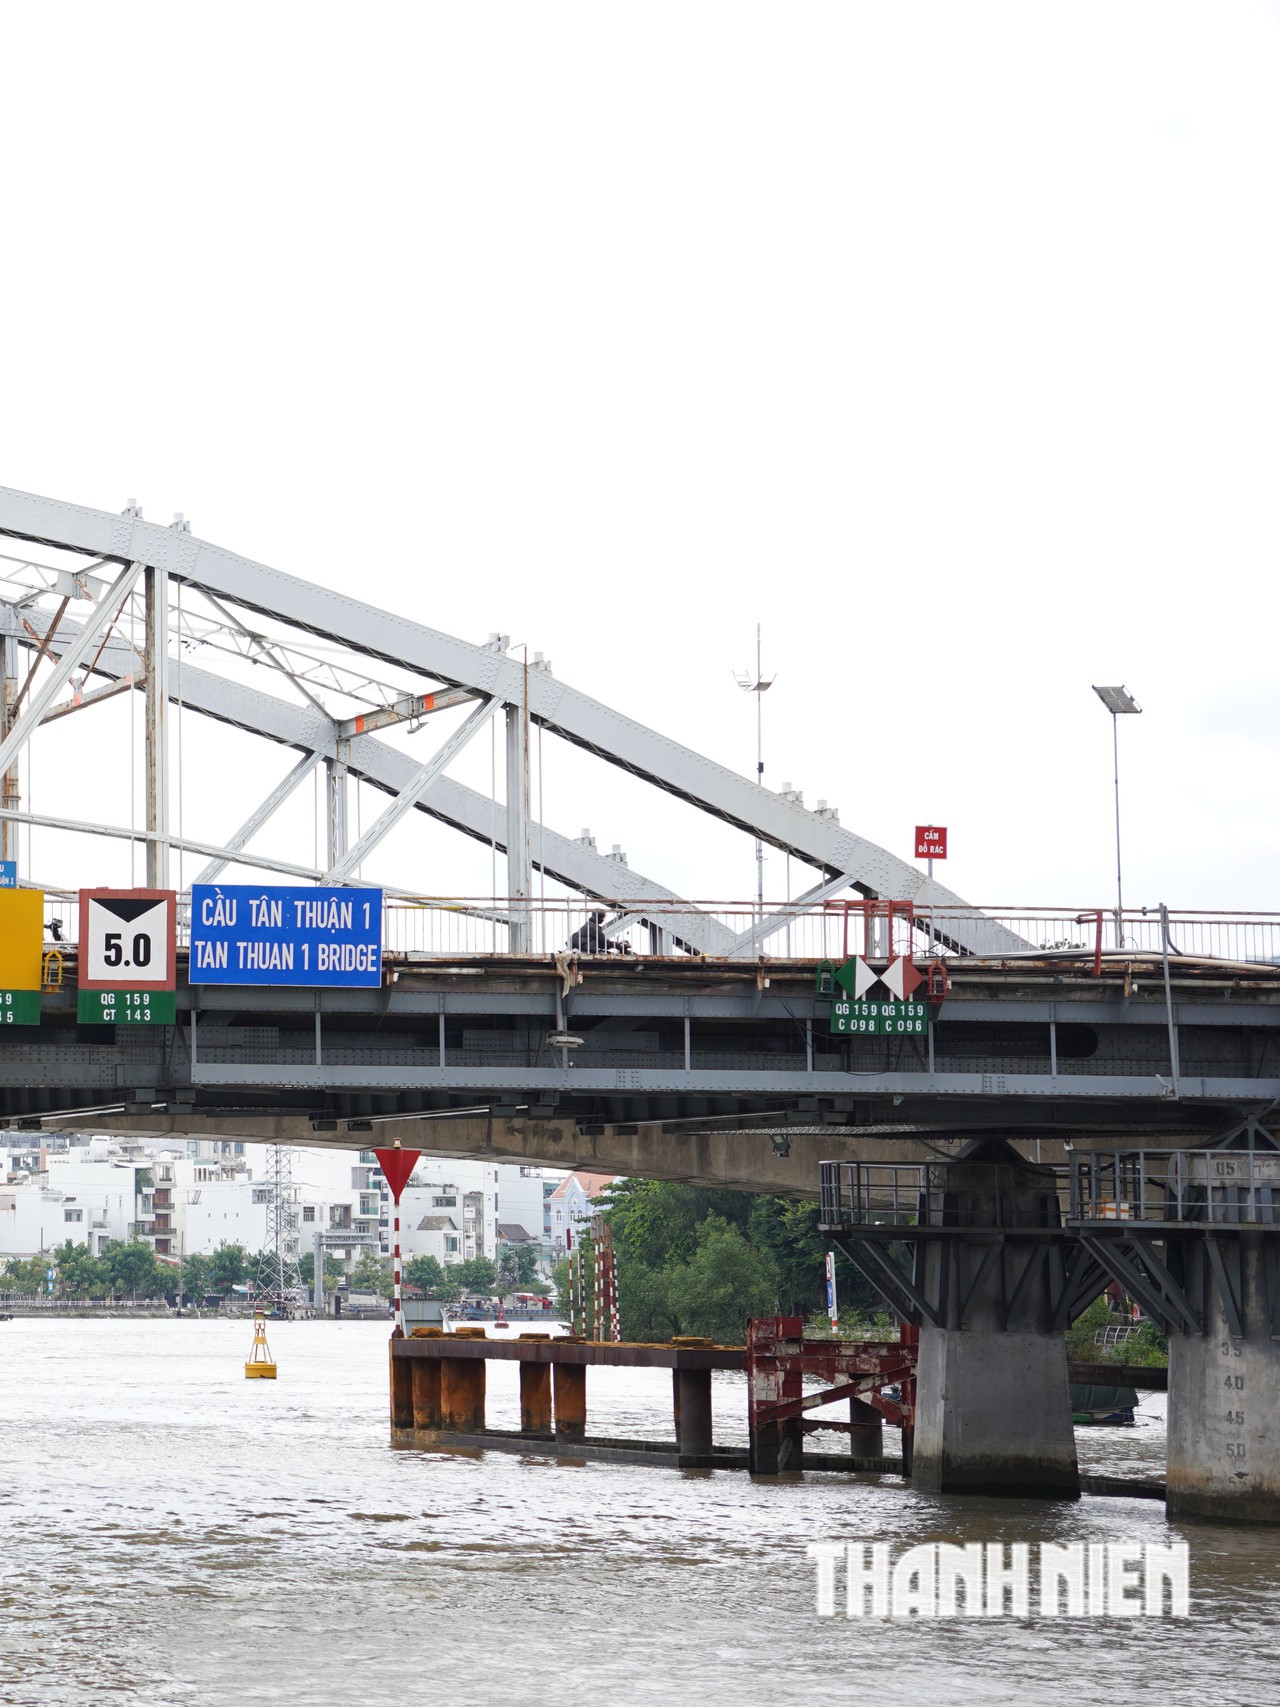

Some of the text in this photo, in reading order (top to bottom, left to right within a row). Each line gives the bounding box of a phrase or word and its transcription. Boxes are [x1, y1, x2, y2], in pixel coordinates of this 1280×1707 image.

[924, 829, 939, 840] CẤM
[930, 844, 944, 854] RÁC
[10, 877, 14, 885] 1
[201, 887, 371, 934] CẦU TÂN THUẬN 1
[104, 933, 151, 968] 5.0
[194, 940, 378, 972] TAN THUAN 1 BRIDGE
[100, 993, 150, 1006] QG 159
[103, 1009, 151, 1021] CT 143
[835, 1003, 877, 1016] QG 159
[881, 1005, 924, 1017] QG 159
[838, 1019, 875, 1031] C 098
[885, 1020, 922, 1032] C 096
